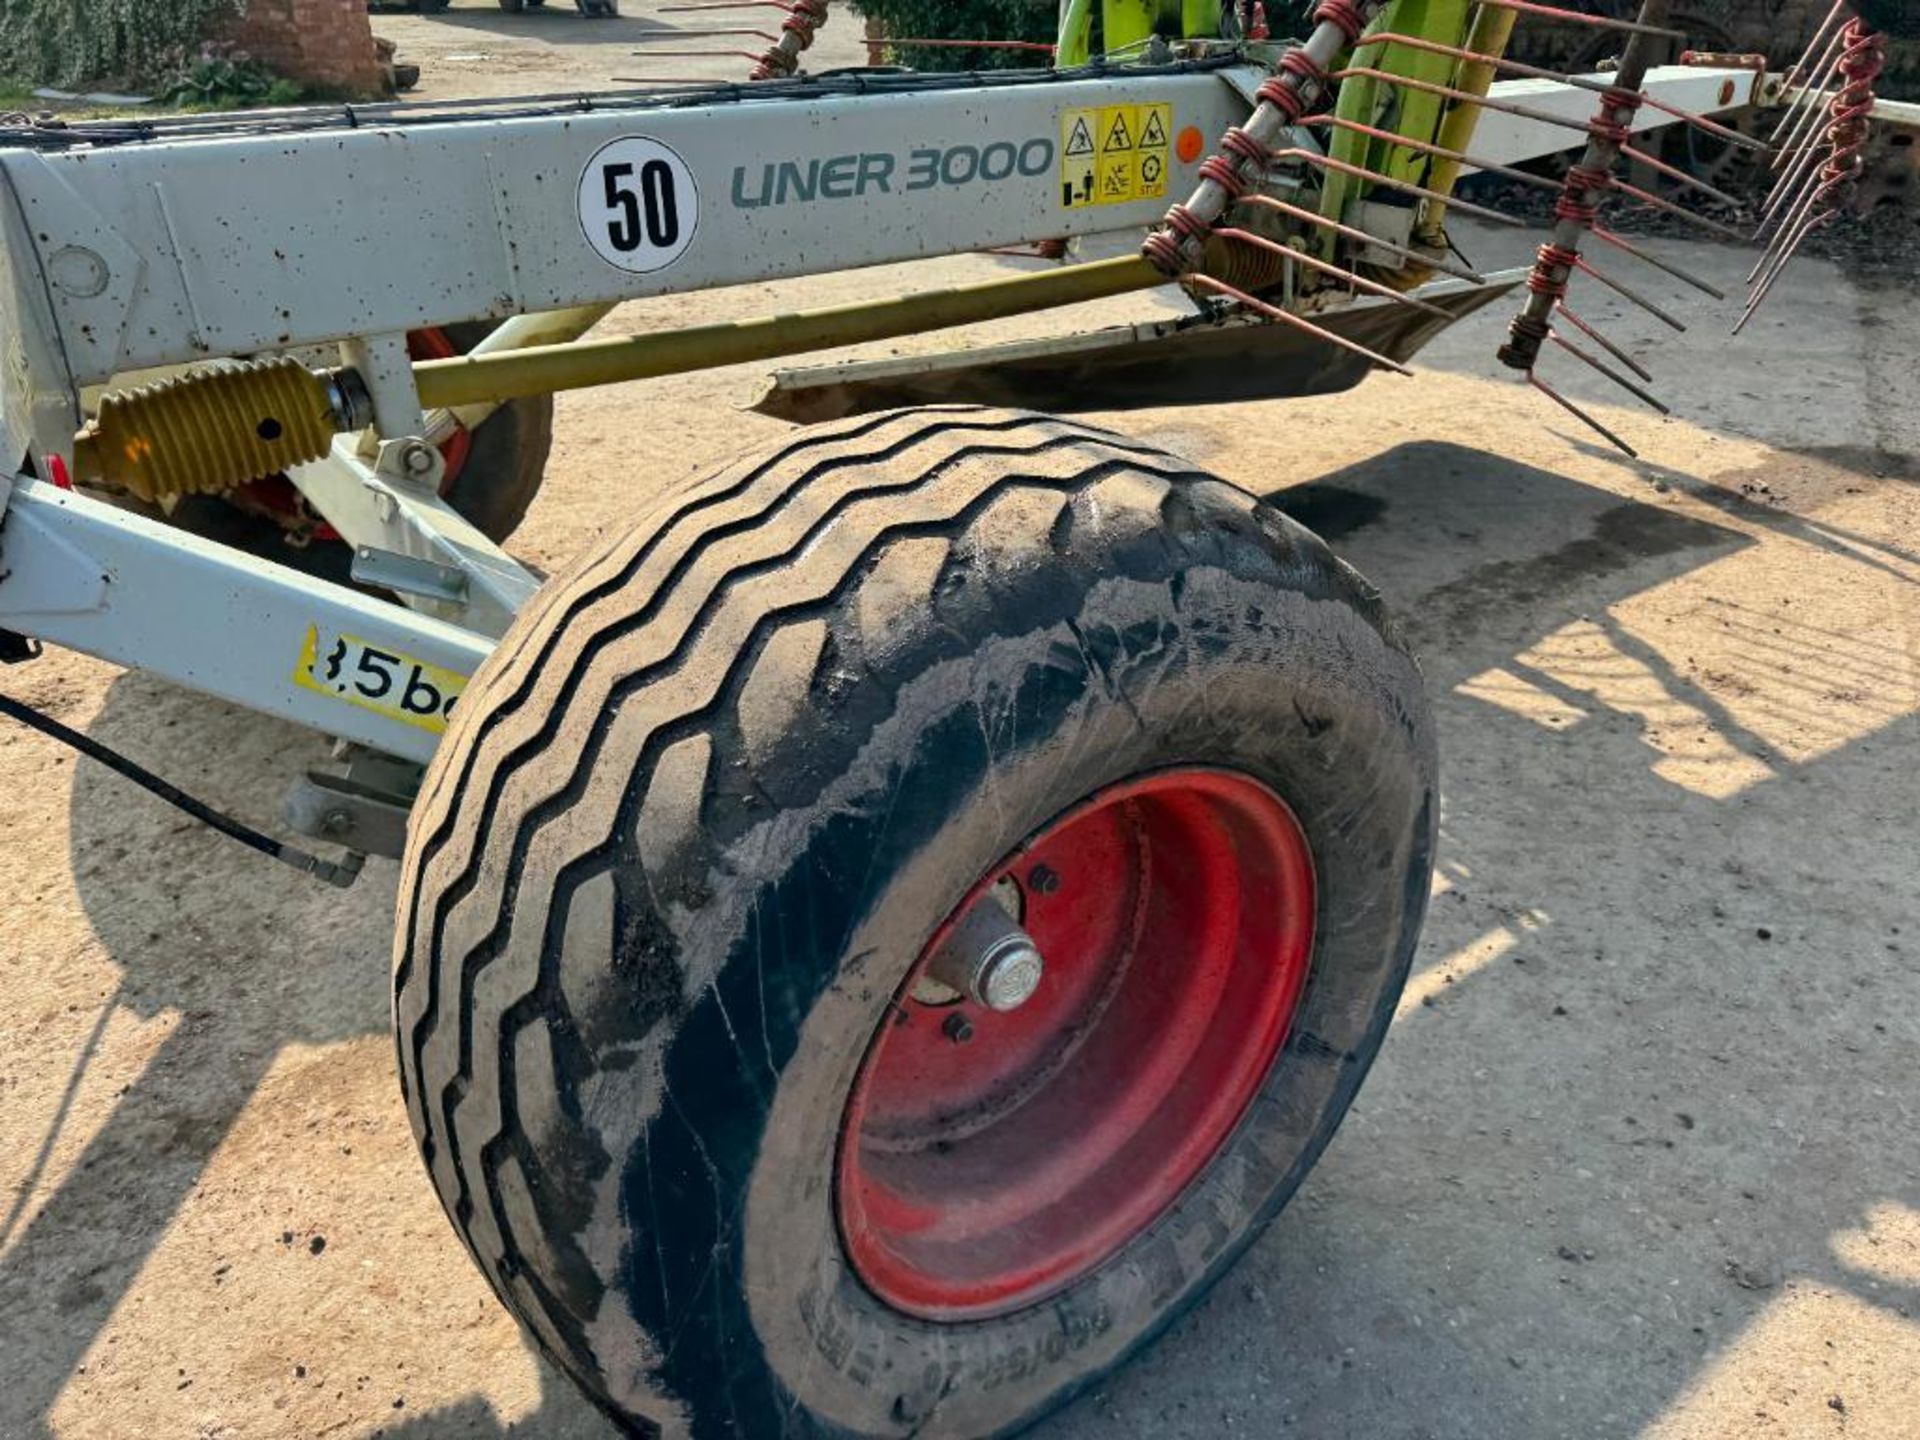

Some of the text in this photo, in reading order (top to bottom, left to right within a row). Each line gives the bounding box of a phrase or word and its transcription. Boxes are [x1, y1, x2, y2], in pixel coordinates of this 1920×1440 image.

[602, 159, 679, 252] 50
[731, 138, 1054, 209] LINER 3000
